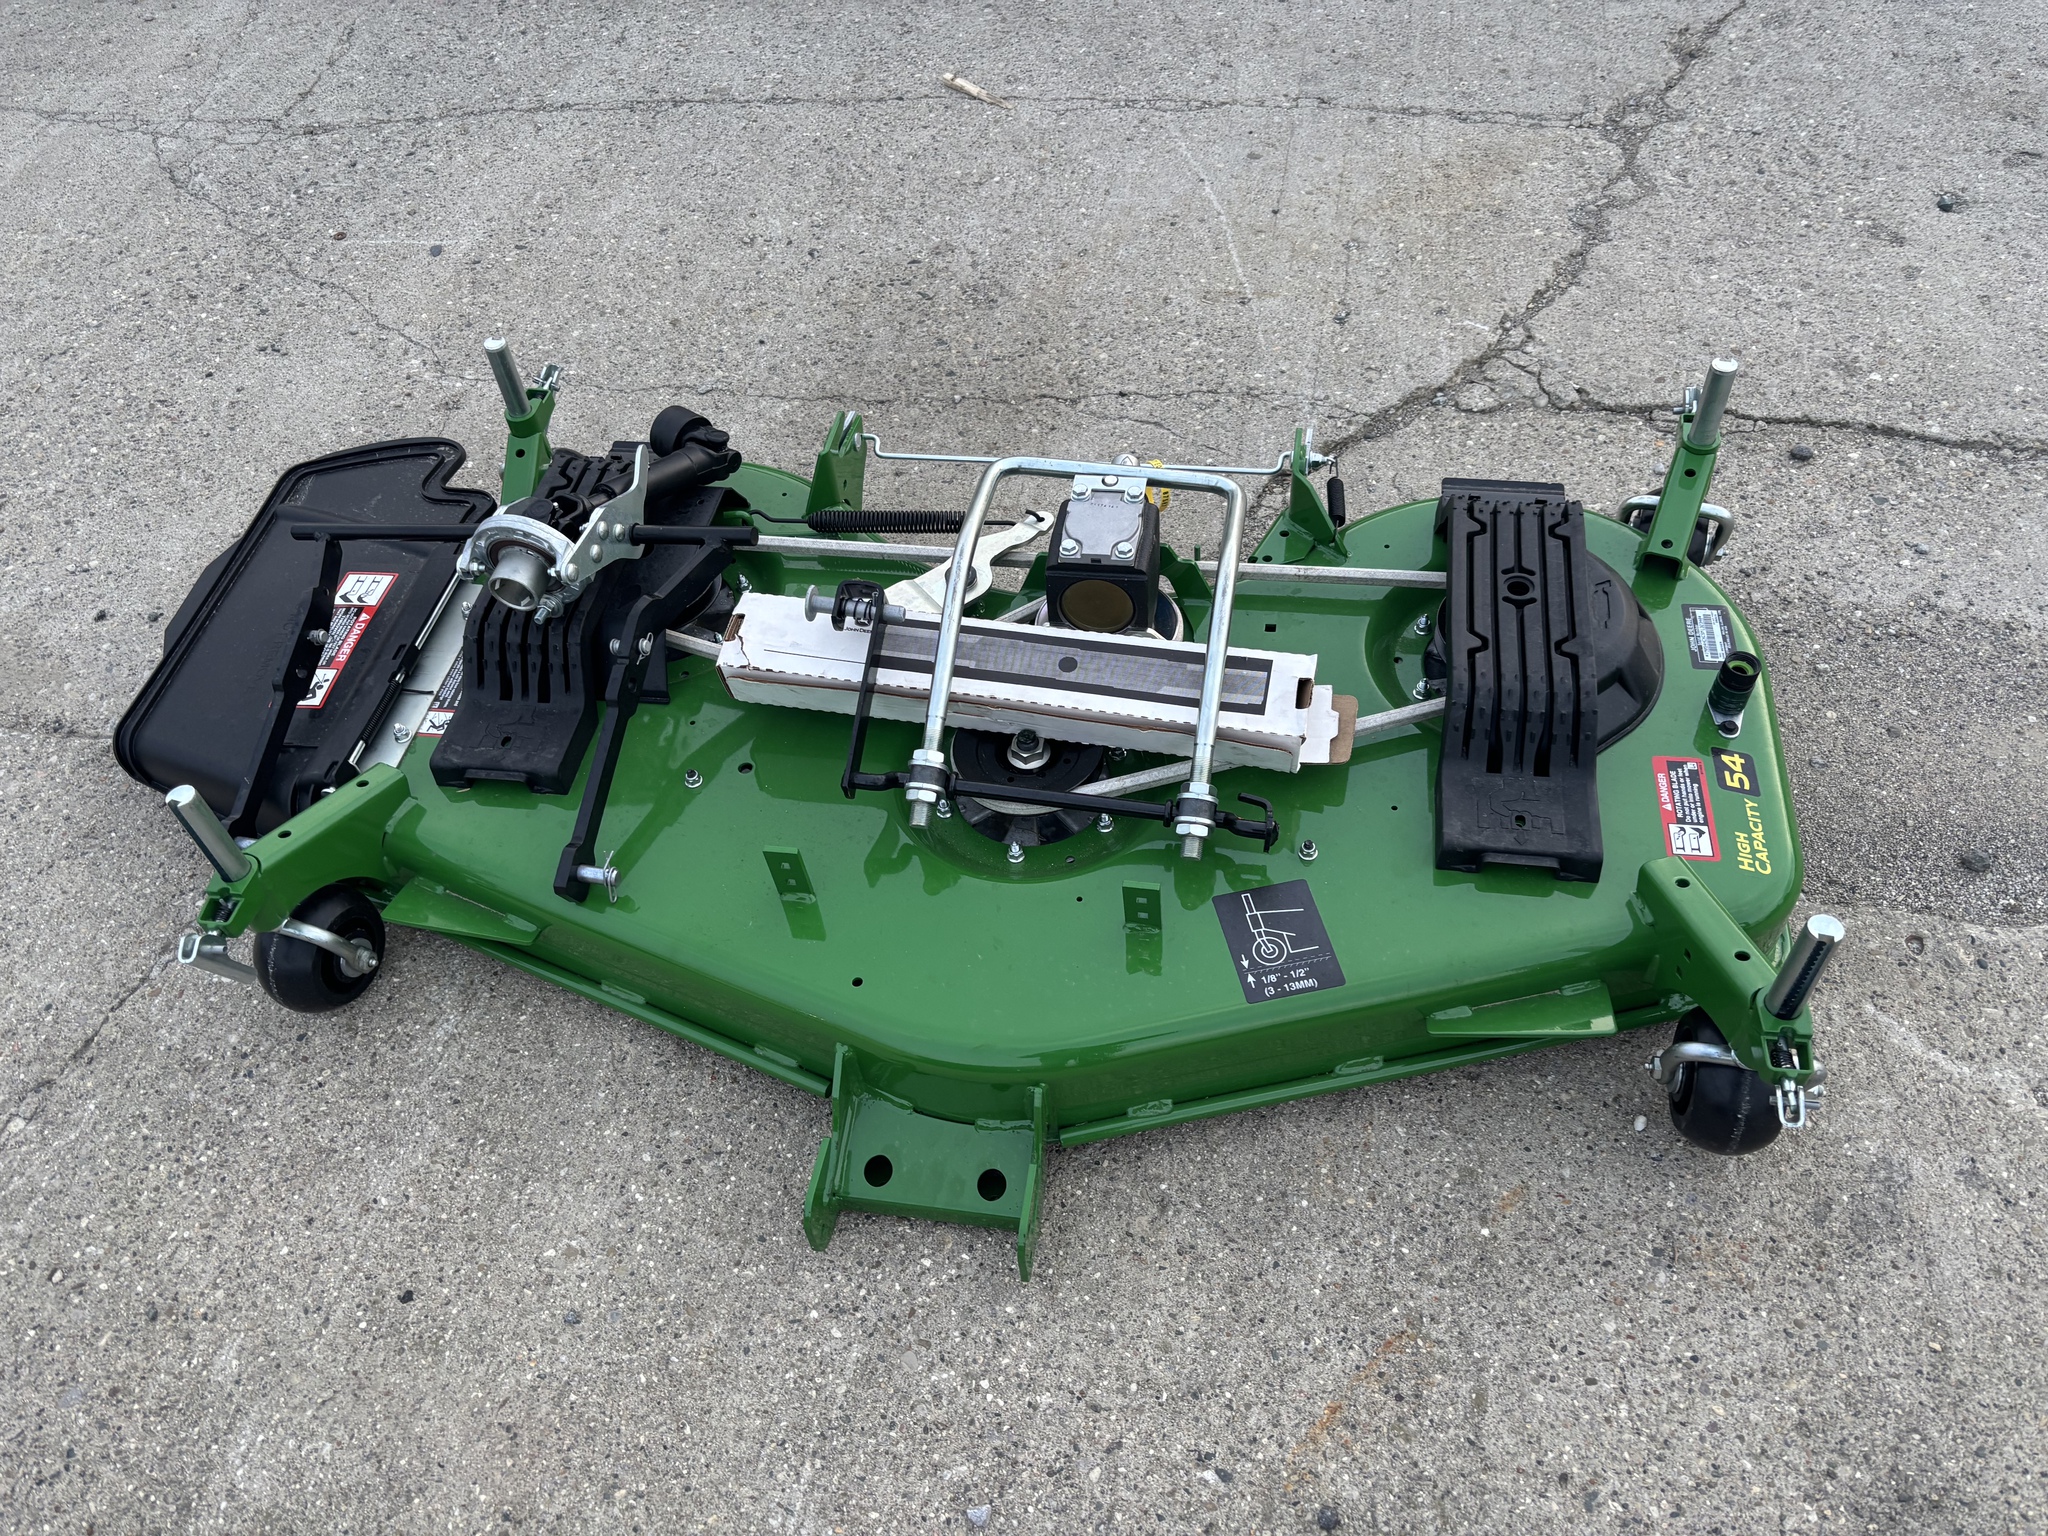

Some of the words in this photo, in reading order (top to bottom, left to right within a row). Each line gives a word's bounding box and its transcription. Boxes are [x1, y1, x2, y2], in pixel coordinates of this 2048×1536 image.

[1685, 617, 1694, 635] DEERE
[334, 622, 366, 661] DANGER
[1689, 636, 1697, 652] JOHN
[1670, 770, 1678, 788] BLADE
[1720, 753, 1750, 791] 54
[1657, 773, 1670, 803] DANGER
[1692, 783, 1700, 801] running
[1672, 788, 1683, 818] ROTATING
[1685, 815, 1691, 823] Do
[1690, 808, 1698, 823] under
[1744, 798, 1772, 875] CAPACITY
[1734, 831, 1756, 872] HIGH
[1264, 986, 1276, 998] (3
[1283, 978, 1318, 992] 13MM)
